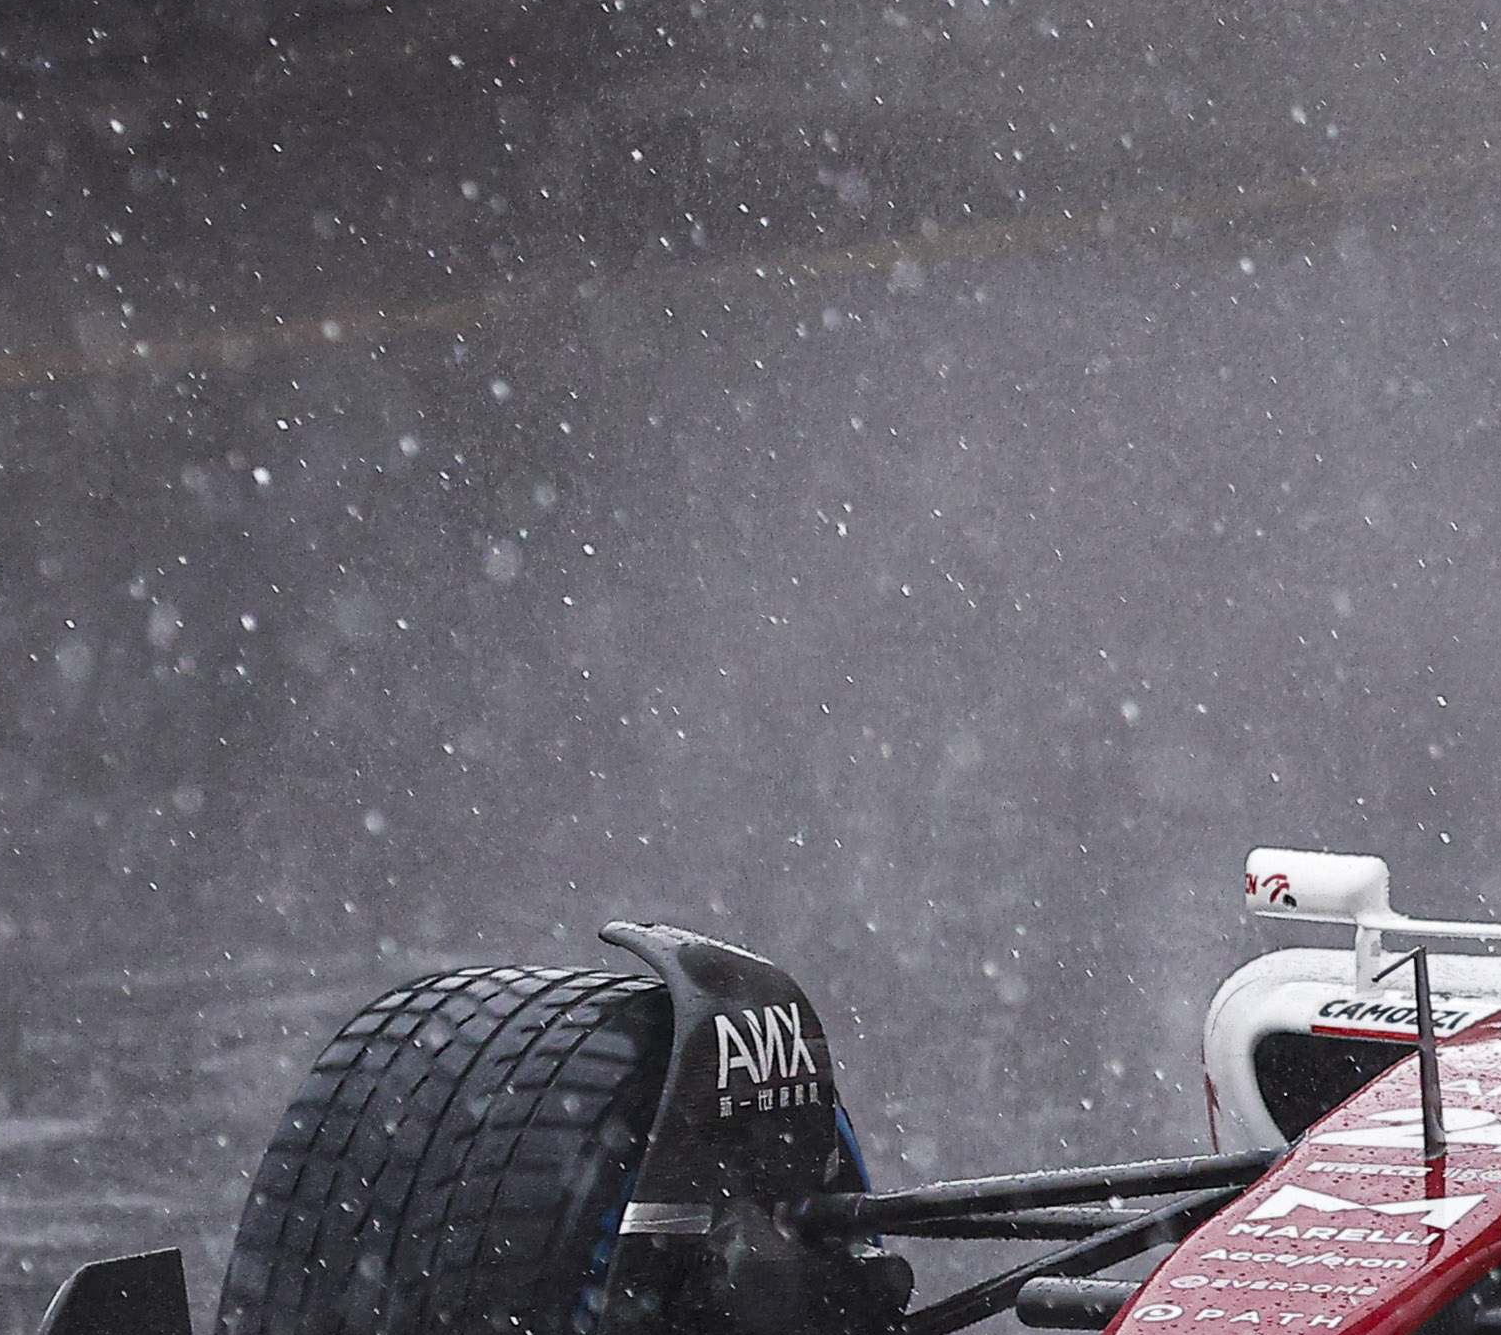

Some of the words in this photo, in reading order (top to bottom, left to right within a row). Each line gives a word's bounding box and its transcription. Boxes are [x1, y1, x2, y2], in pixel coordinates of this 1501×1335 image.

[1226, 1222, 1441, 1246] MARELLI
[1210, 1278, 1380, 1296] EVERDOME
[1194, 1308, 1345, 1329] PATH
